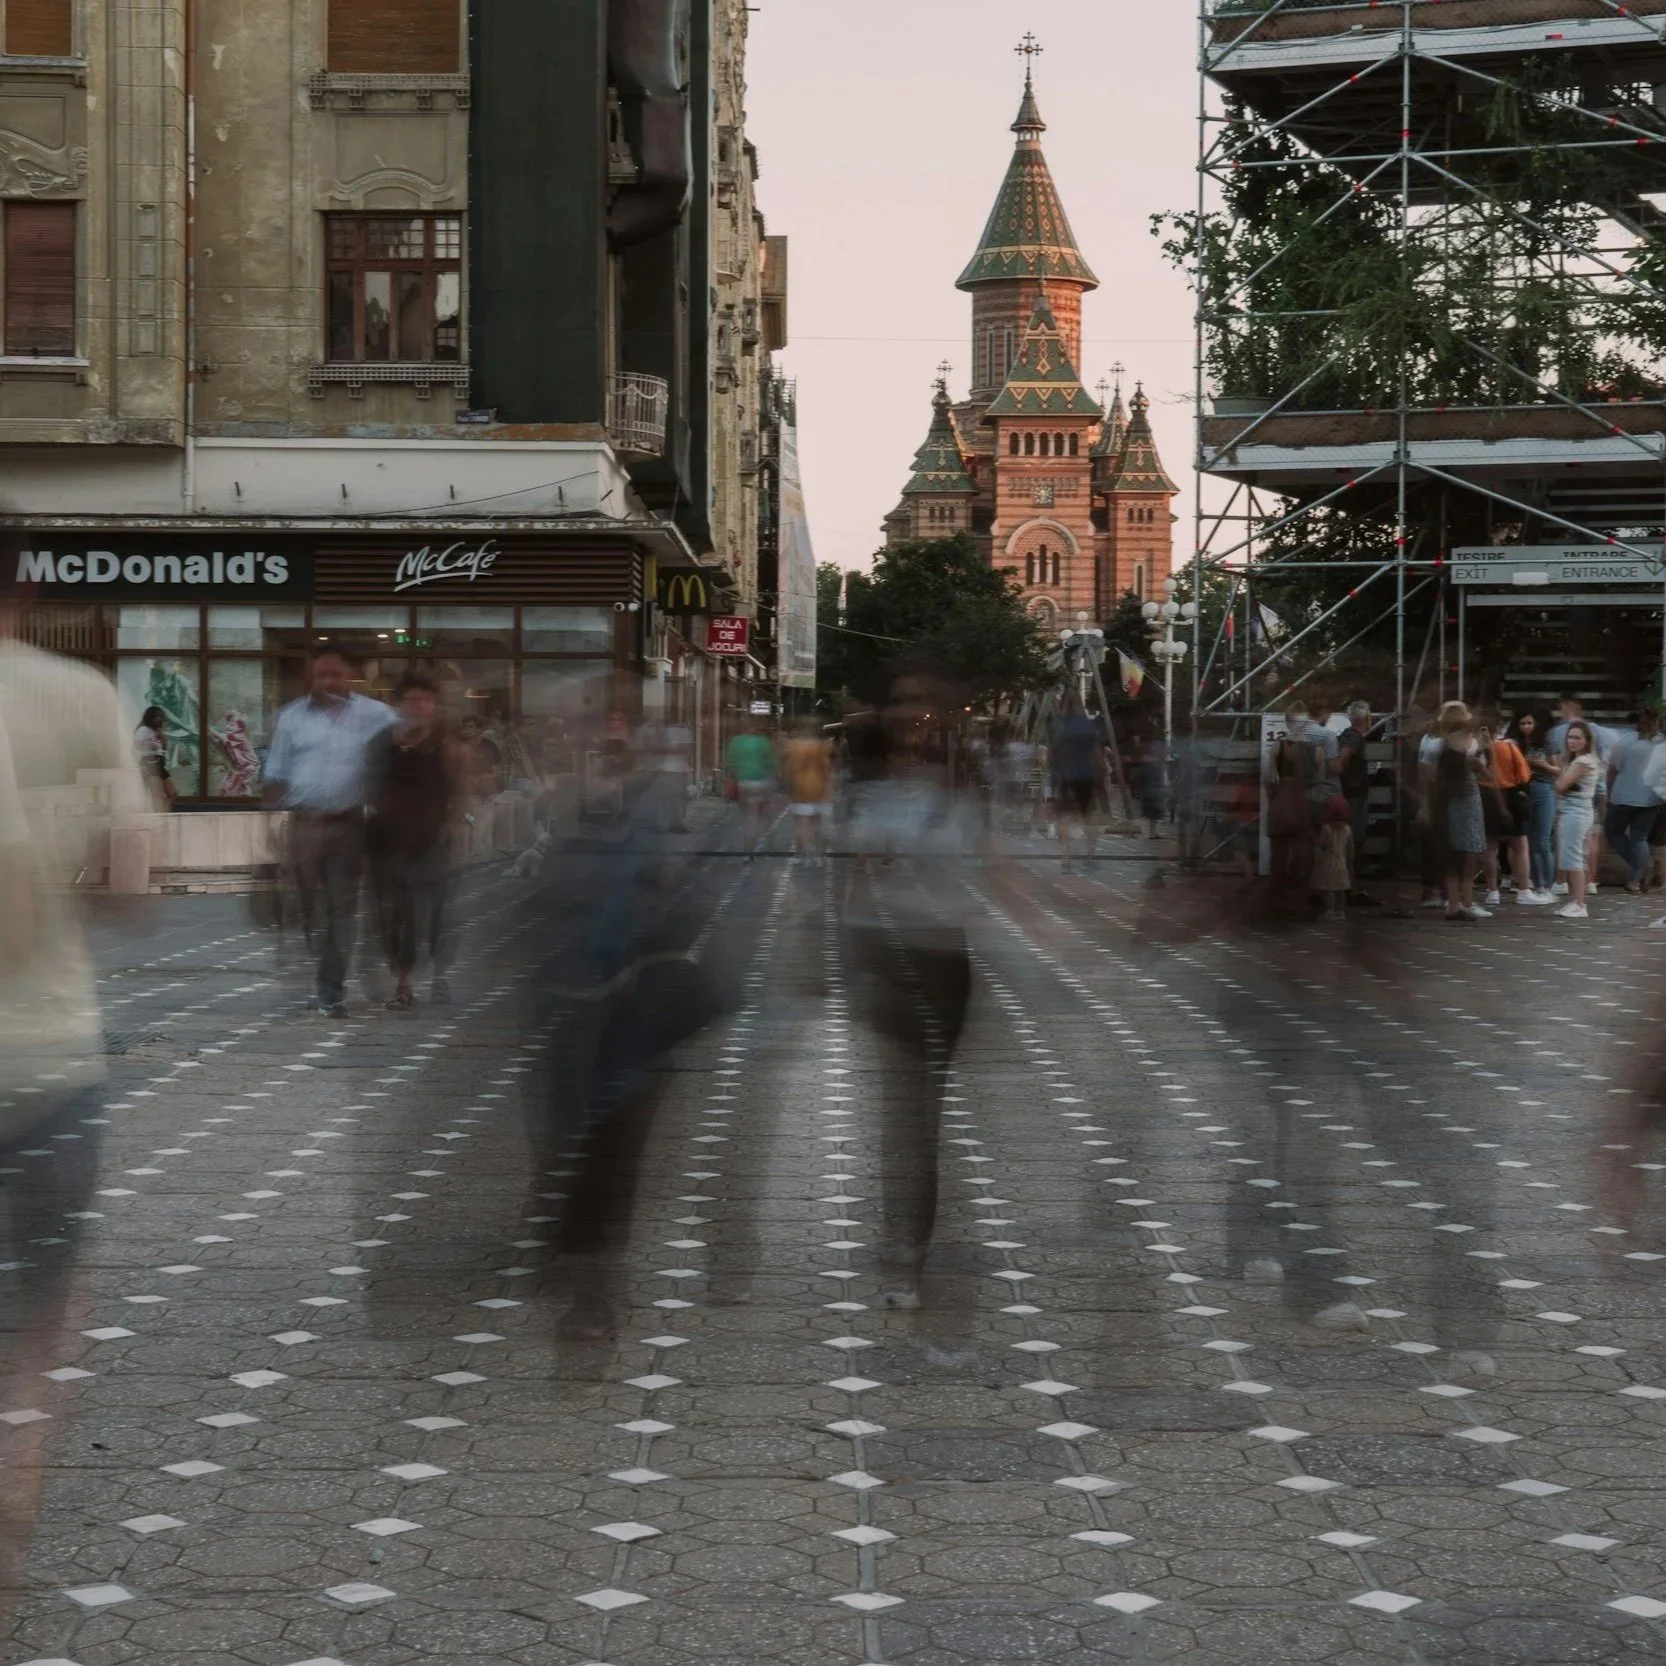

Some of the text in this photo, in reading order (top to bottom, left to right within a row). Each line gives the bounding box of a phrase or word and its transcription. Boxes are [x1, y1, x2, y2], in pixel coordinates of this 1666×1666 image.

[395, 539, 501, 583] McCafé
[16, 551, 289, 584] McDonald's
[1562, 567, 1639, 578] ENTRANCE
[1455, 568, 1489, 579] EXIT
[712, 619, 743, 629] SALA
[719, 630, 736, 640] DE
